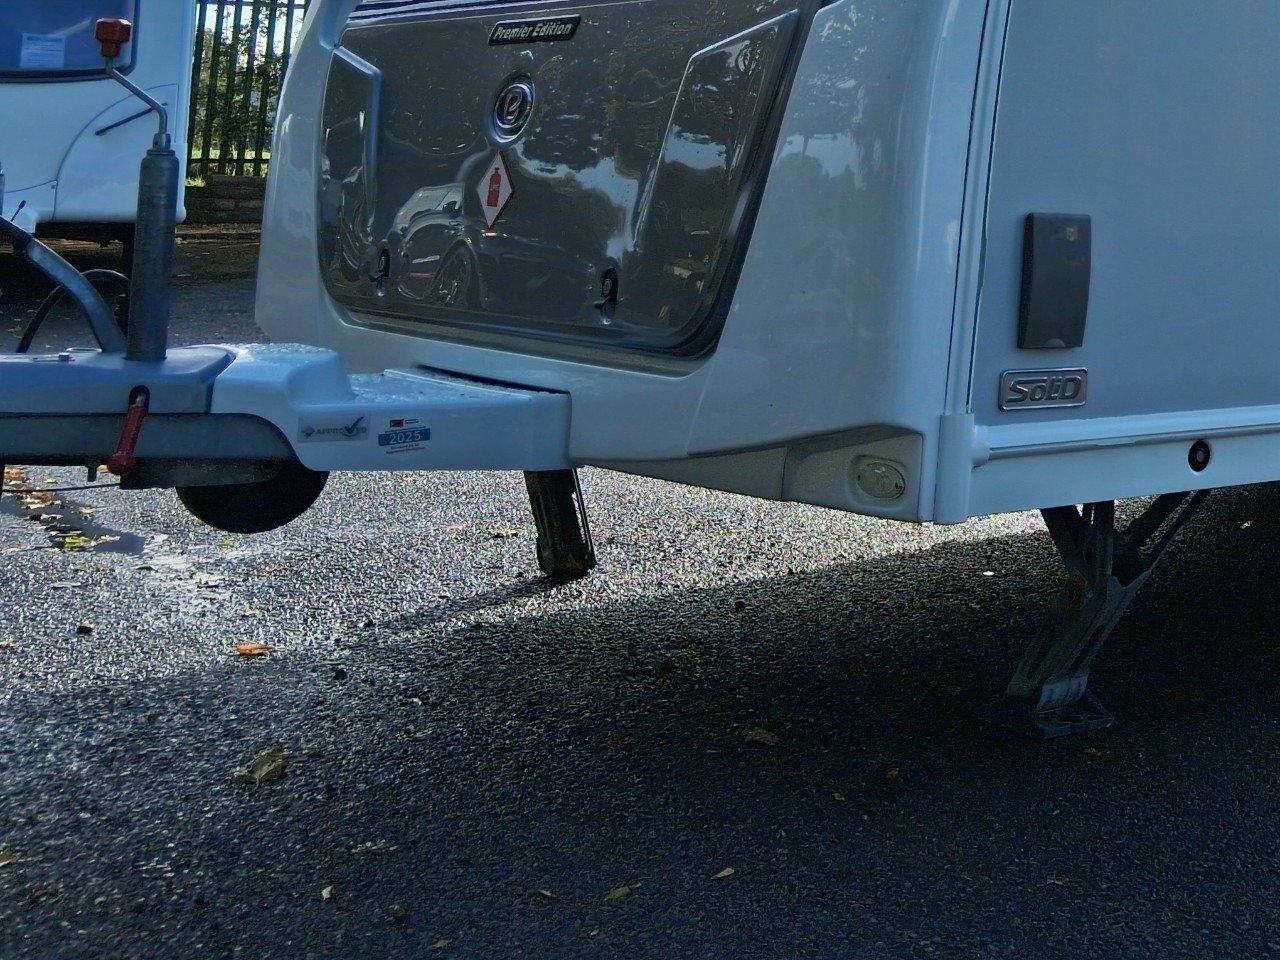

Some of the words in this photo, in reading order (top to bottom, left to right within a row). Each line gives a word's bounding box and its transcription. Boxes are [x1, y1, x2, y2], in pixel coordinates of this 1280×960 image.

[493, 24, 534, 40] Premier
[532, 21, 573, 37] Edition
[389, 430, 421, 444] 2025
